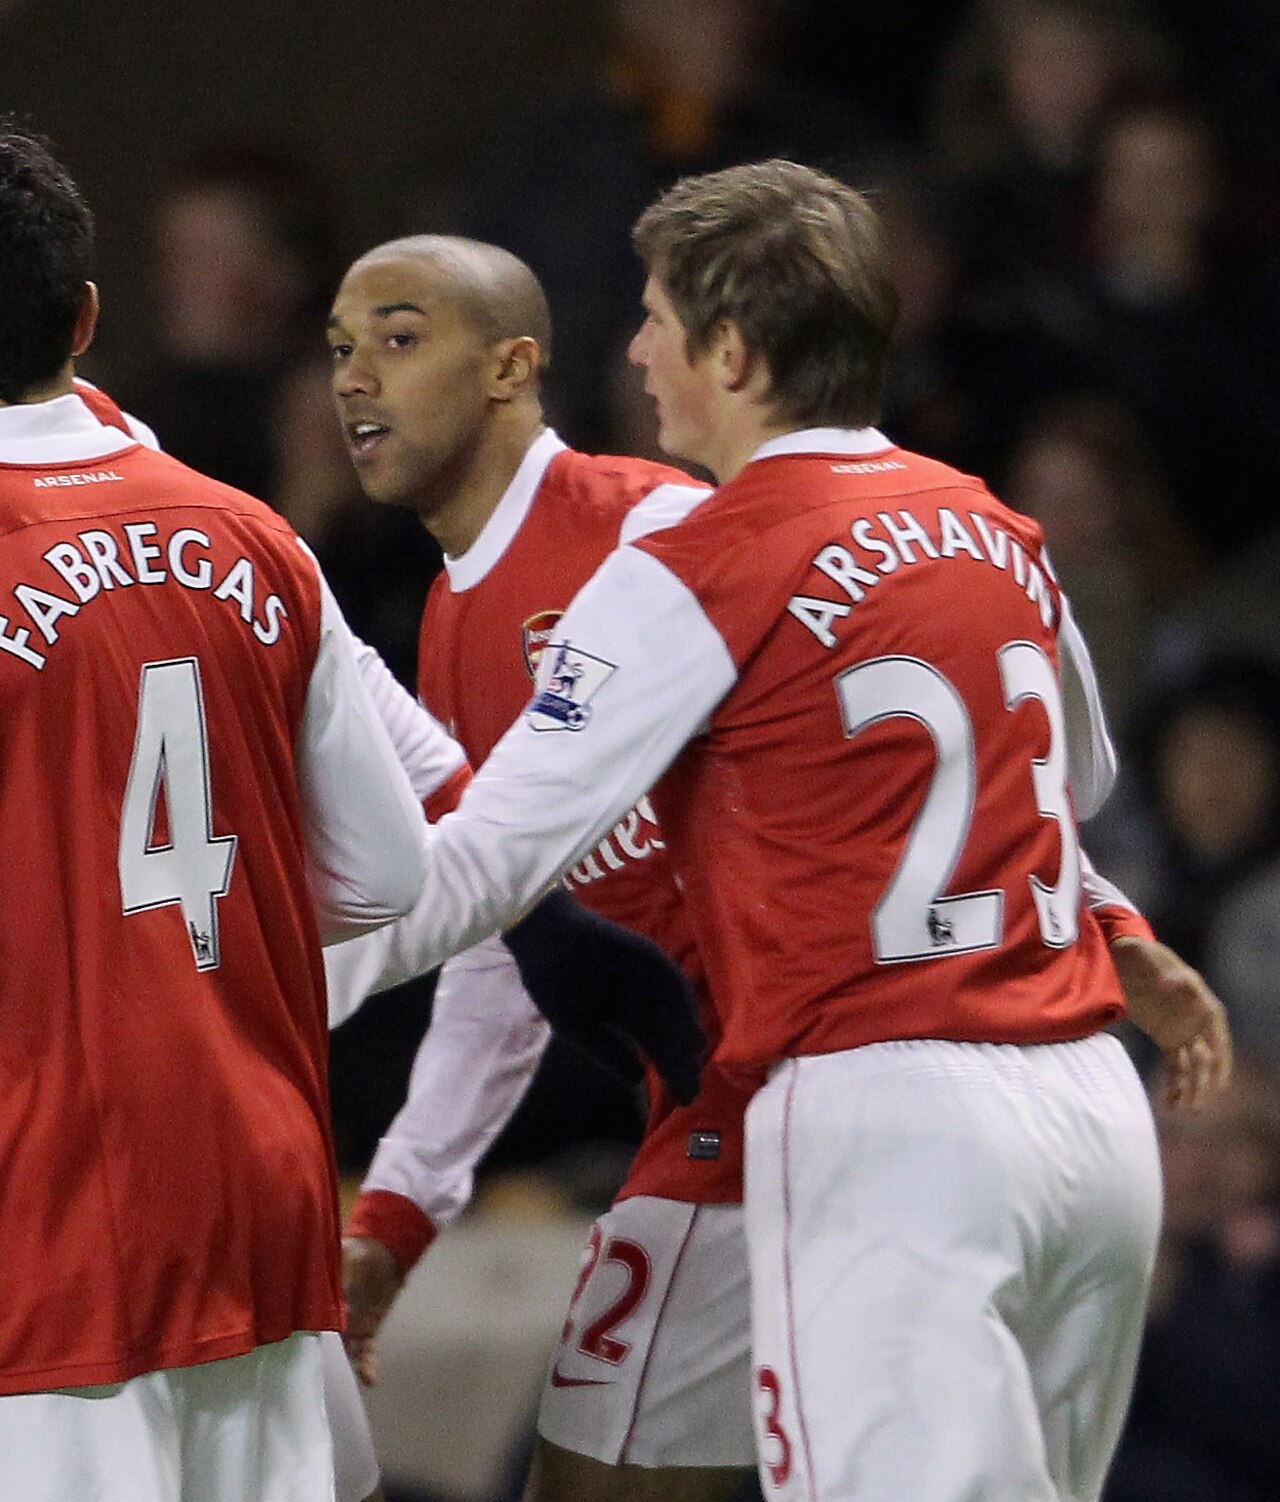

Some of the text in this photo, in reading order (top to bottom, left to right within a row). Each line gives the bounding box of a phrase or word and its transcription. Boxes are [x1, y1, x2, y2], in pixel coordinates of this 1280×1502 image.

[33, 471, 125, 488] ARSENAL
[787, 507, 1053, 648] ARSHAVIN
[119, 656, 238, 972] 4
[835, 640, 1081, 965] 23
